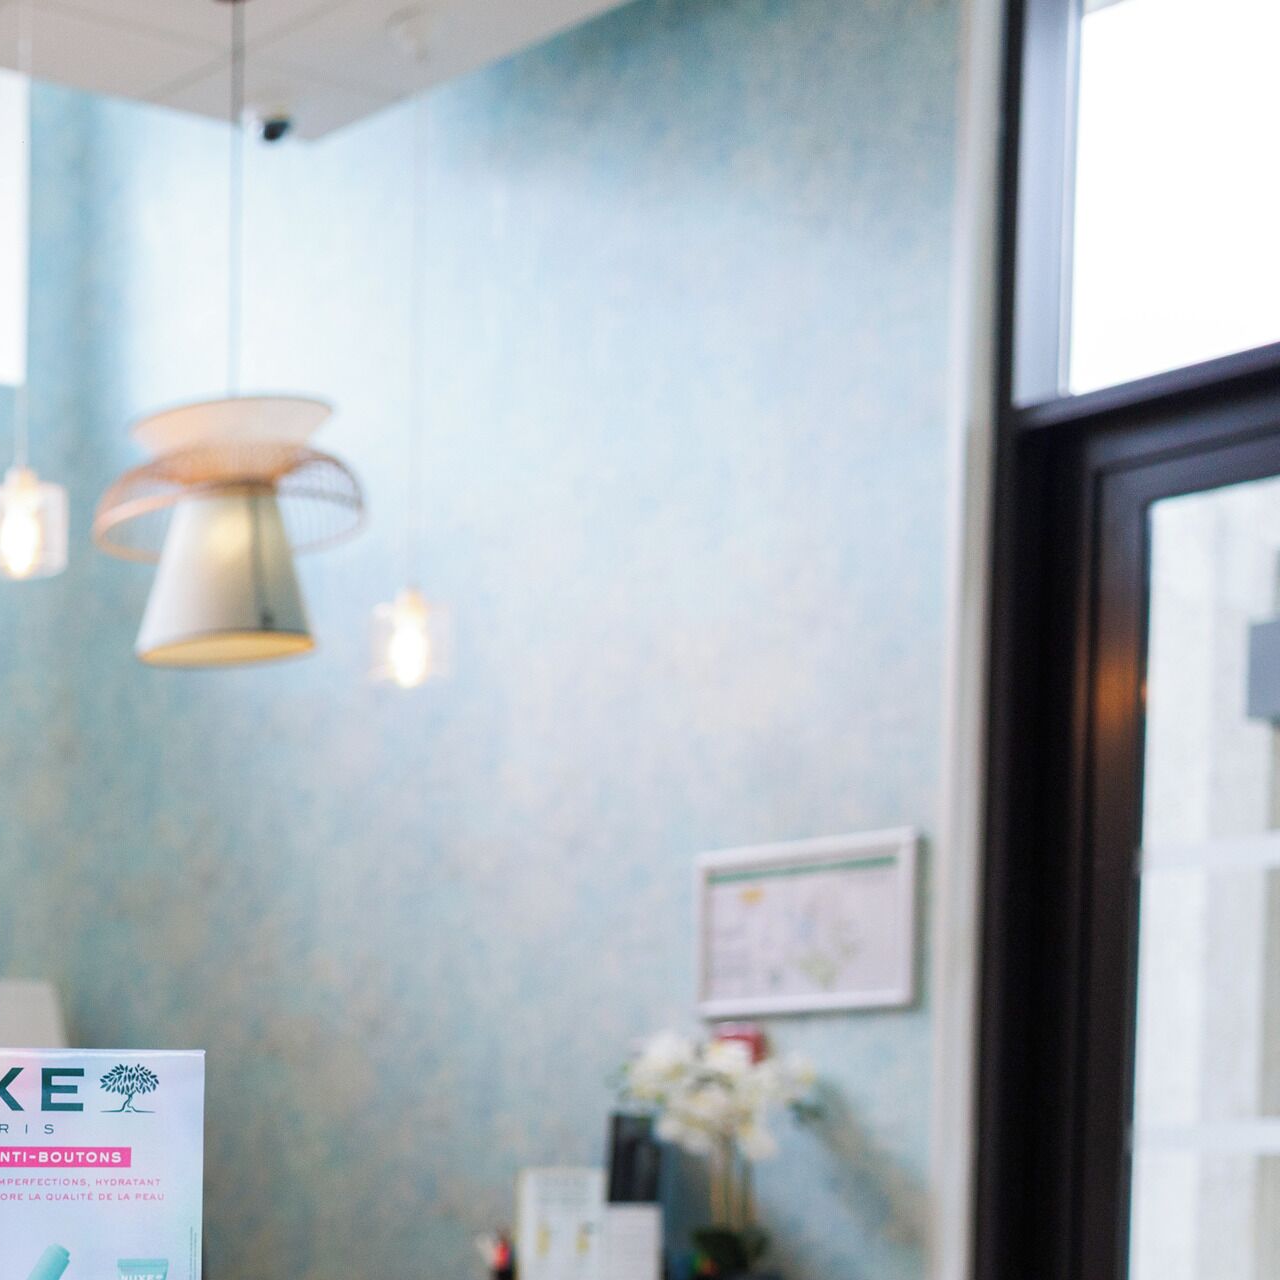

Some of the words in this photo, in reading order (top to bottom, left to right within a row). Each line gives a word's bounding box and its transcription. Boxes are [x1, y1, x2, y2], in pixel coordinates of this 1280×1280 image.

[95, 1178, 160, 1186] HYDRATANT
[29, 1193, 41, 1201] LA
[46, 1191, 93, 1201] QUALITÉ
[99, 1193, 113, 1201] DE
[118, 1193, 130, 1201] LA
[135, 1192, 164, 1201] PEAU
